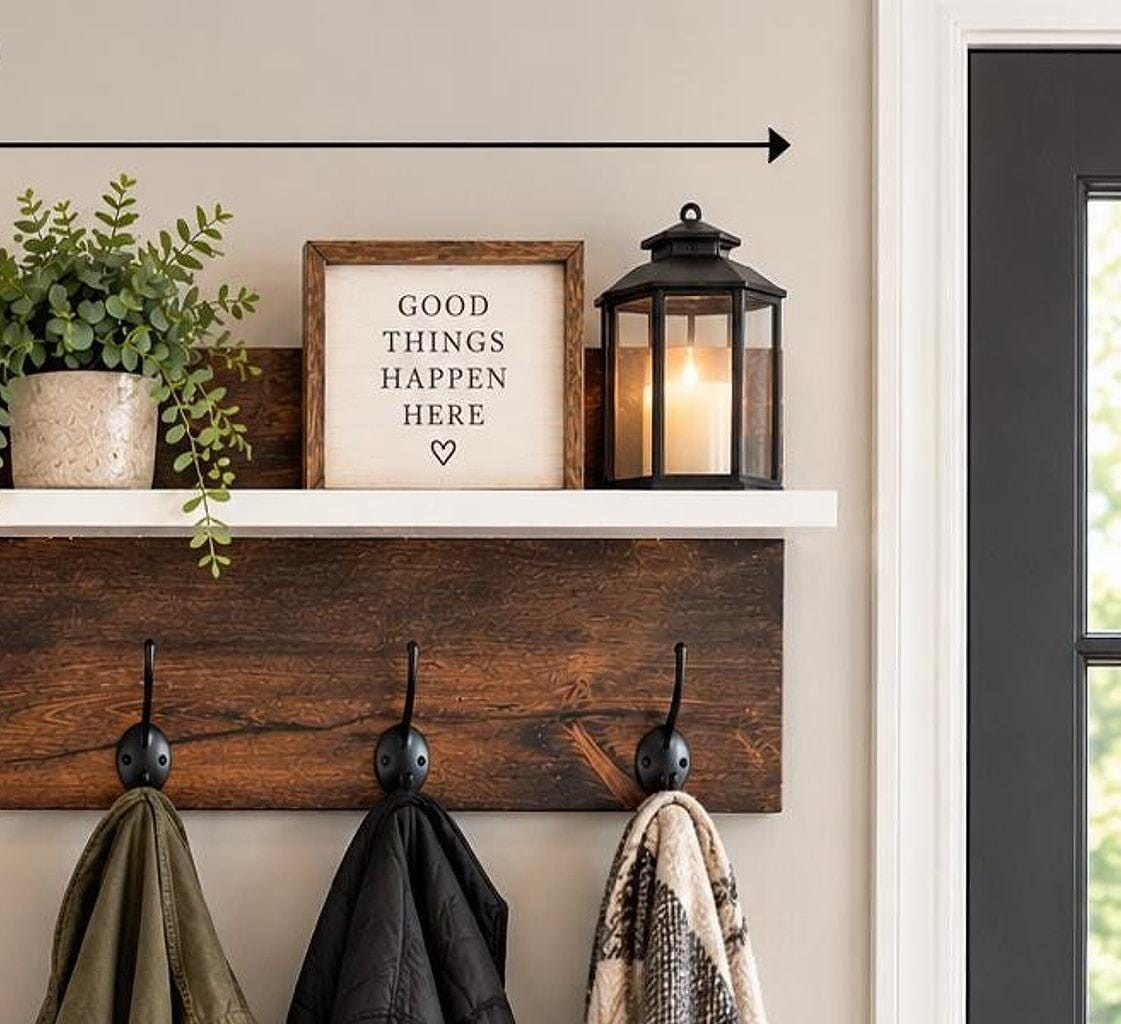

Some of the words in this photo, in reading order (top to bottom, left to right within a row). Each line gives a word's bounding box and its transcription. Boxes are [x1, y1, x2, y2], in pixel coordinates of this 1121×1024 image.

[397, 294, 490, 317] GOOD
[382, 330, 505, 353] THINGS
[380, 367, 507, 389] HAPPEN
[403, 403, 485, 425] HERE
